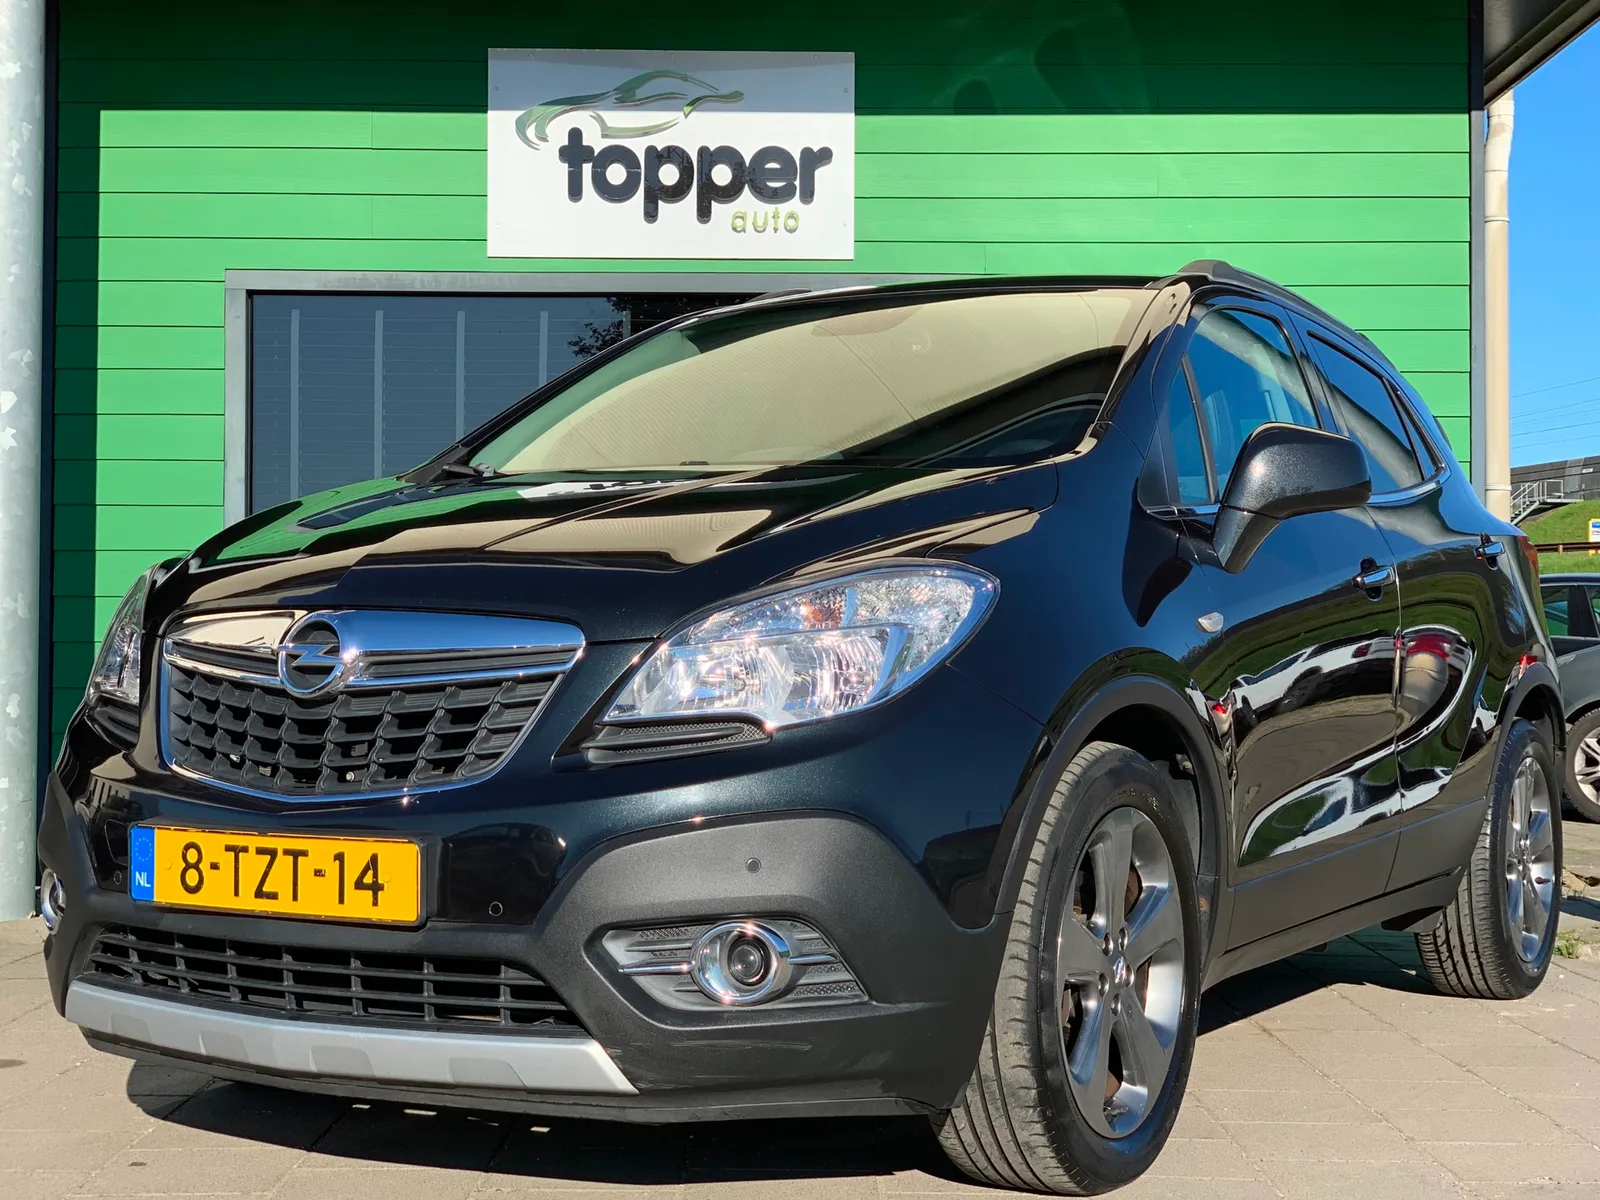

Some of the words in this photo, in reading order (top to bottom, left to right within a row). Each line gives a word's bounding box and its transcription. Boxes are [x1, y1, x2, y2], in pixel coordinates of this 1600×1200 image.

[559, 127, 833, 223] topper
[731, 207, 800, 233] auto
[135, 872, 152, 888] NL
[180, 841, 385, 907] 8-TZT-14
